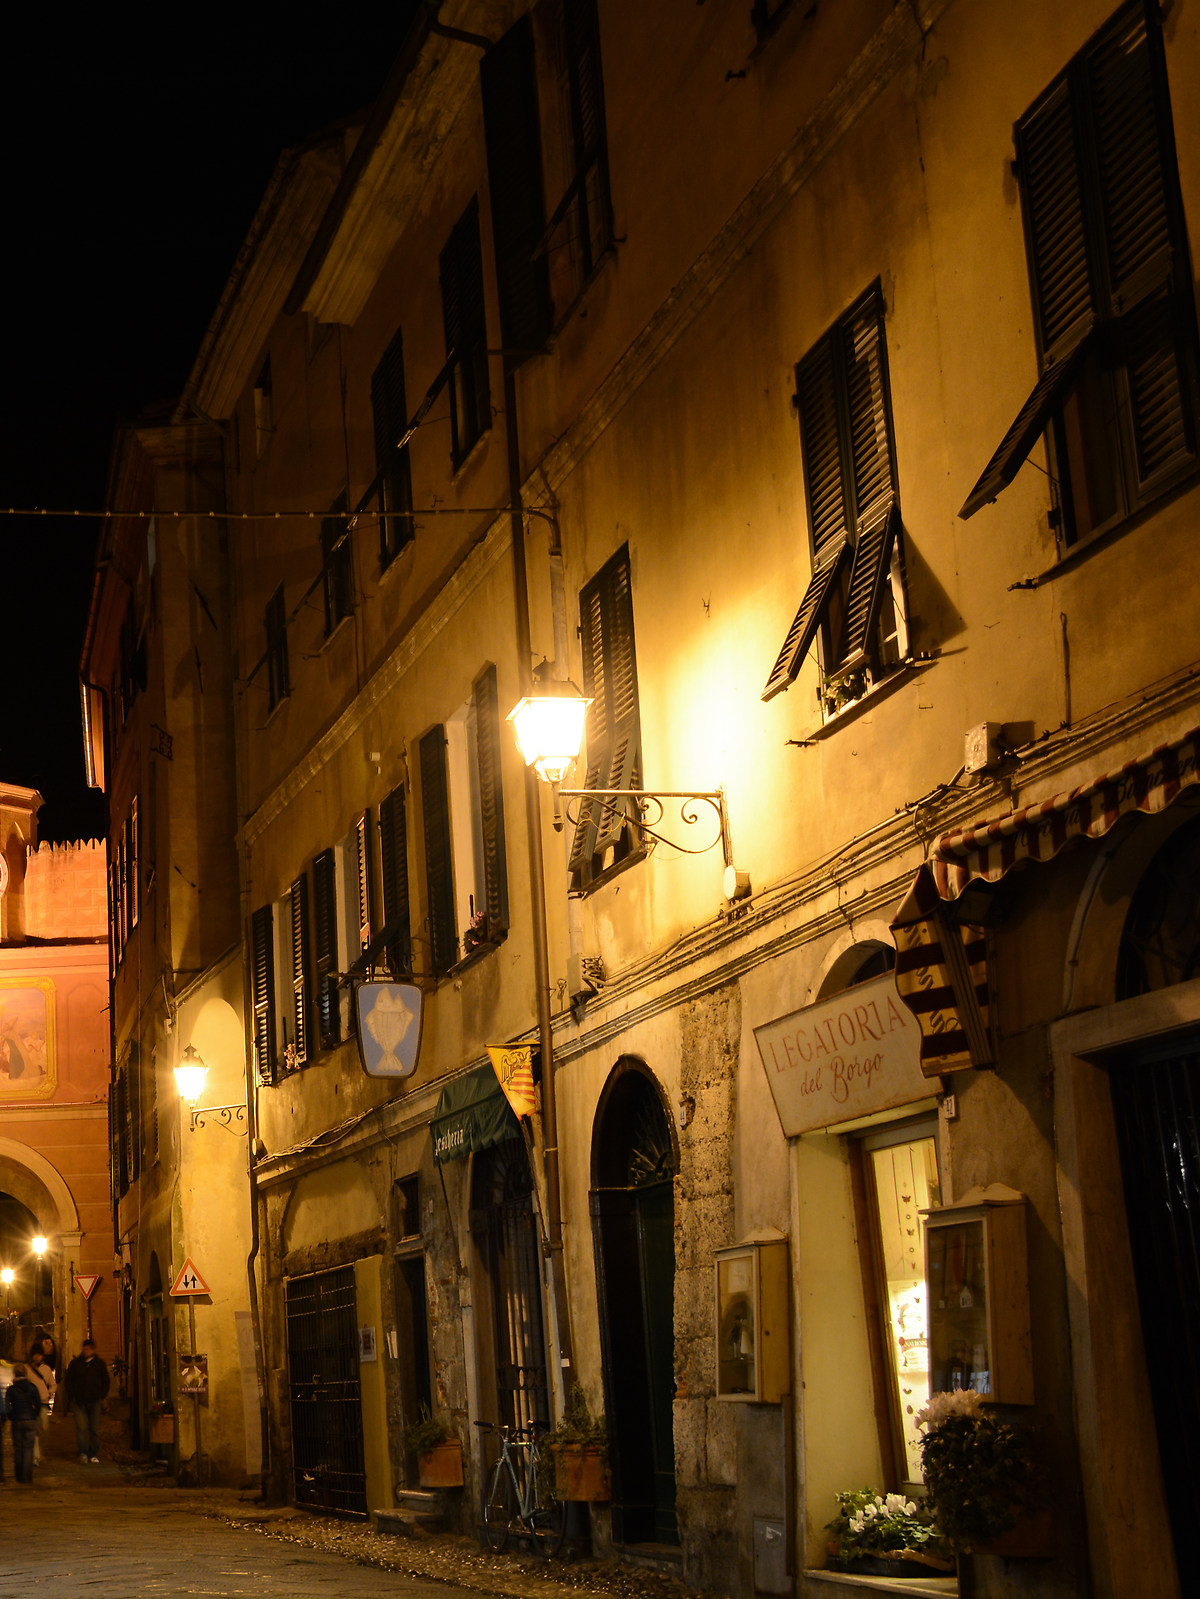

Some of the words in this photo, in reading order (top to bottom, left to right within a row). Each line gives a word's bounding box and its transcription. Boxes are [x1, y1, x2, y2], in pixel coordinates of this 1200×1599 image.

[769, 995, 907, 1073] LEGATORIA
[800, 1067, 823, 1096] del
[830, 1052, 885, 1104] Borgo
